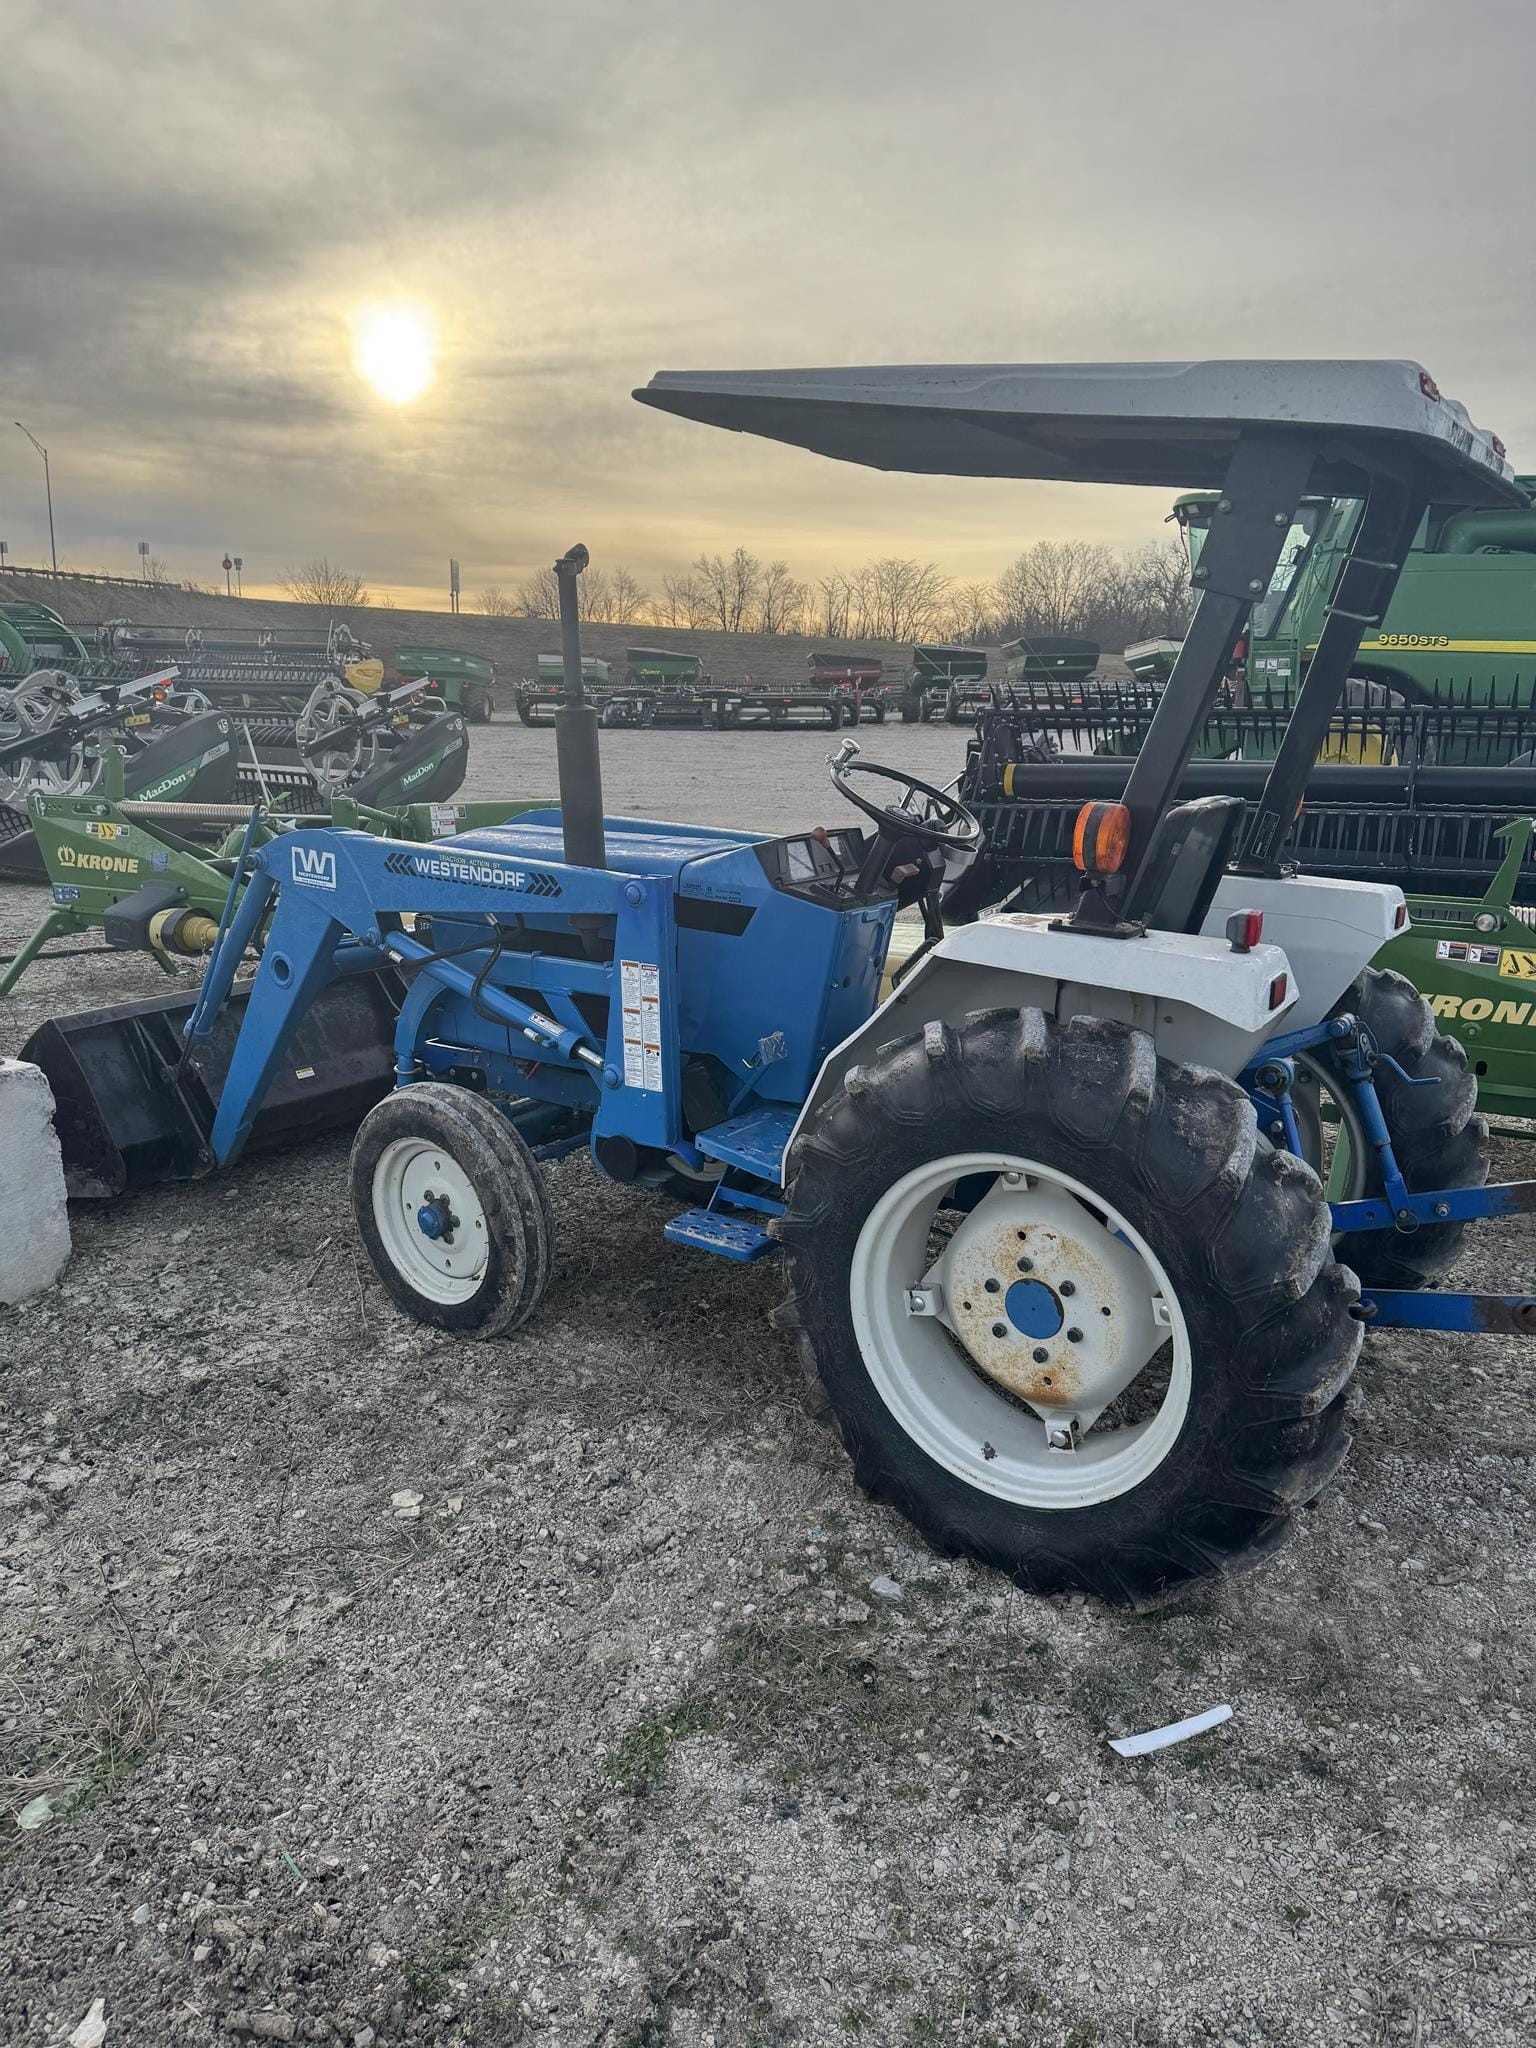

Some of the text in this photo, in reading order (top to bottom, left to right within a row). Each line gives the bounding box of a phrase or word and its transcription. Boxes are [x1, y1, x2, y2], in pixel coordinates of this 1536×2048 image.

[1378, 634, 1449, 646] 9650STS
[403, 762, 434, 786] MacDon
[139, 774, 187, 802] MacDon
[77, 853, 139, 873] KRONE
[415, 857, 525, 887] WESTENDORF
[469, 859, 490, 867] ACTION
